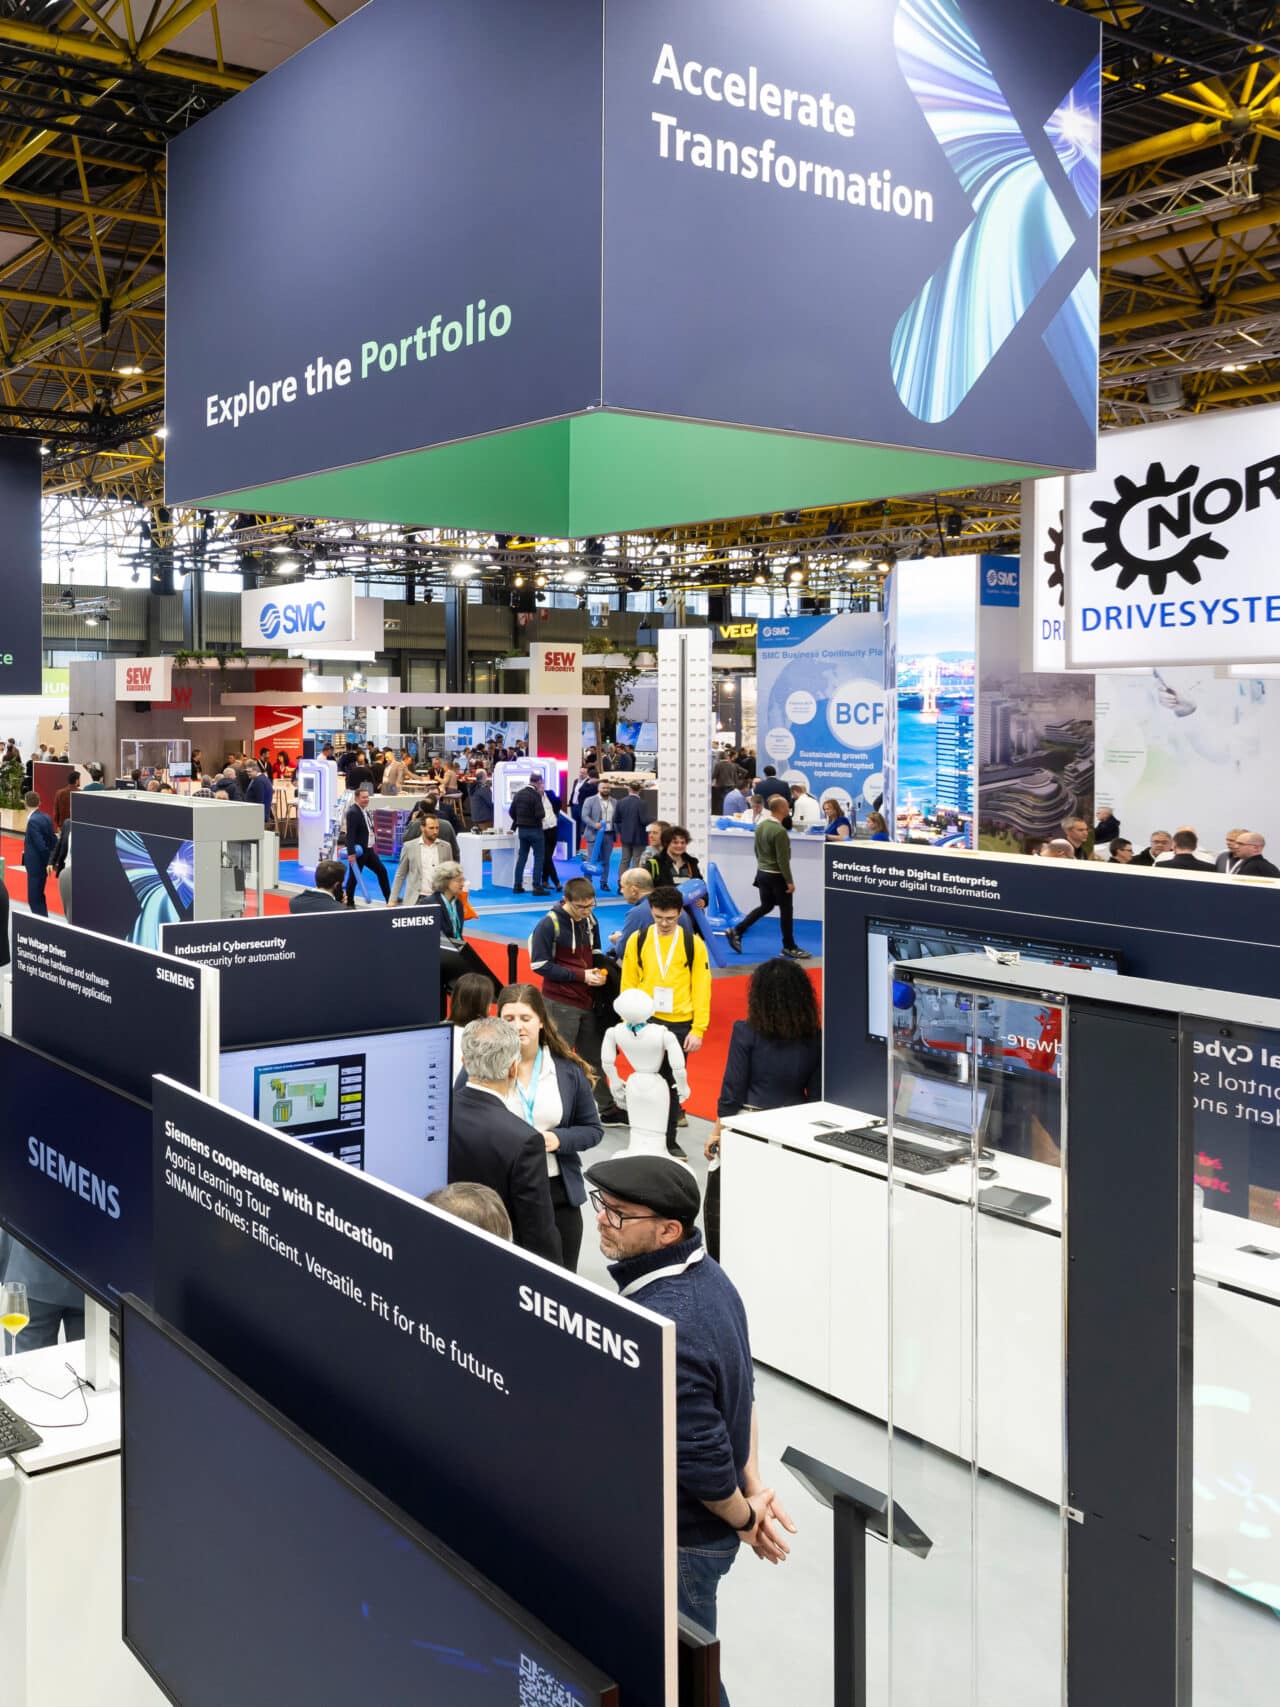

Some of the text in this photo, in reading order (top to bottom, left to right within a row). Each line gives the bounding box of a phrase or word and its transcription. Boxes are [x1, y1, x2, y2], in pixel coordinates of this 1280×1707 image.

[651, 43, 855, 137] Accelerate
[651, 111, 934, 222] Transformation
[205, 299, 512, 428] Explore the Portfolio
[283, 601, 326, 634] SMC
[545, 651, 576, 666] SEW
[782, 650, 819, 659] Business
[822, 648, 866, 659] Continuity
[126, 667, 152, 684] SEW
[842, 752, 868, 761] growth
[814, 770, 853, 778] operations
[832, 860, 998, 888] Services for the Digital Enterprise
[832, 872, 1001, 900] Partner for your digital transformation
[392, 915, 435, 928] SIEMENS
[17, 933, 67, 958] Low Voltage Drives
[175, 937, 286, 955] Industrial Cybersecurity
[234, 954, 247, 964] for
[248, 950, 296, 963] automation
[17, 946, 110, 988] Sinamics drive hardware and software
[156, 967, 195, 990] SIEMENS
[17, 959, 112, 1004] The right function for every application
[28, 1135, 121, 1219] SIEMENS
[164, 1120, 393, 1261] Siemens cooperates with Education
[165, 1145, 272, 1219] Agoria Learning Tour
[165, 1169, 510, 1395] SINAMICS drives: Efficient. Versatile. Fit for the future.
[518, 1284, 641, 1369] SIEMENS
